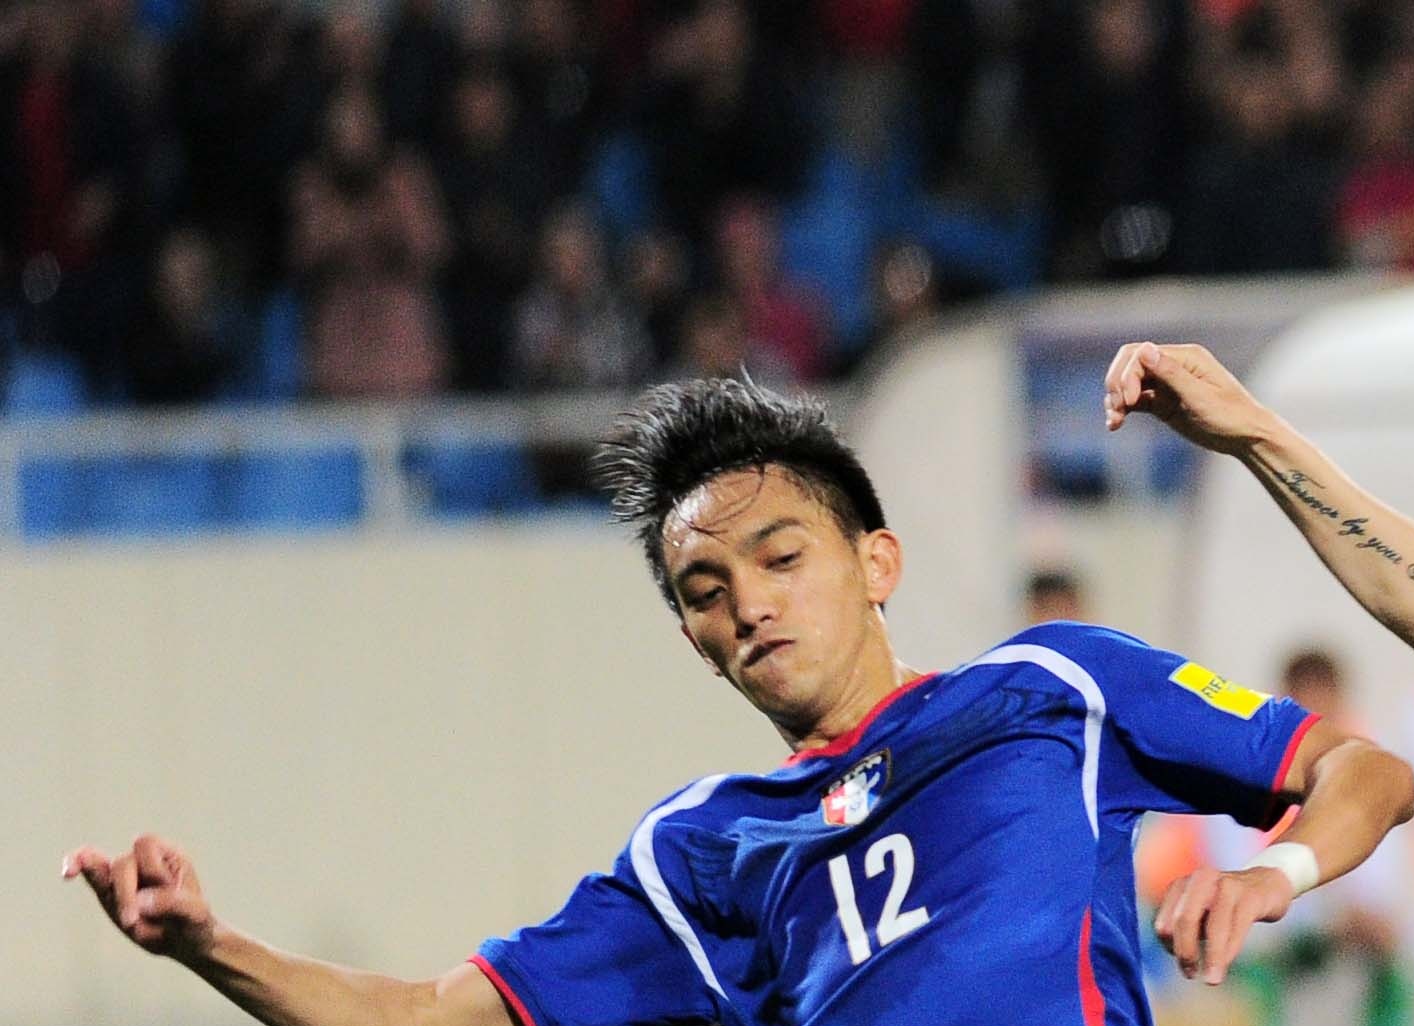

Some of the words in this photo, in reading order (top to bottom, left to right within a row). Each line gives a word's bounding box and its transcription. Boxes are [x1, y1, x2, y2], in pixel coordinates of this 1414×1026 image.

[1338, 517, 1369, 536] by
[1356, 537, 1404, 564] your
[828, 833, 929, 965] 12
